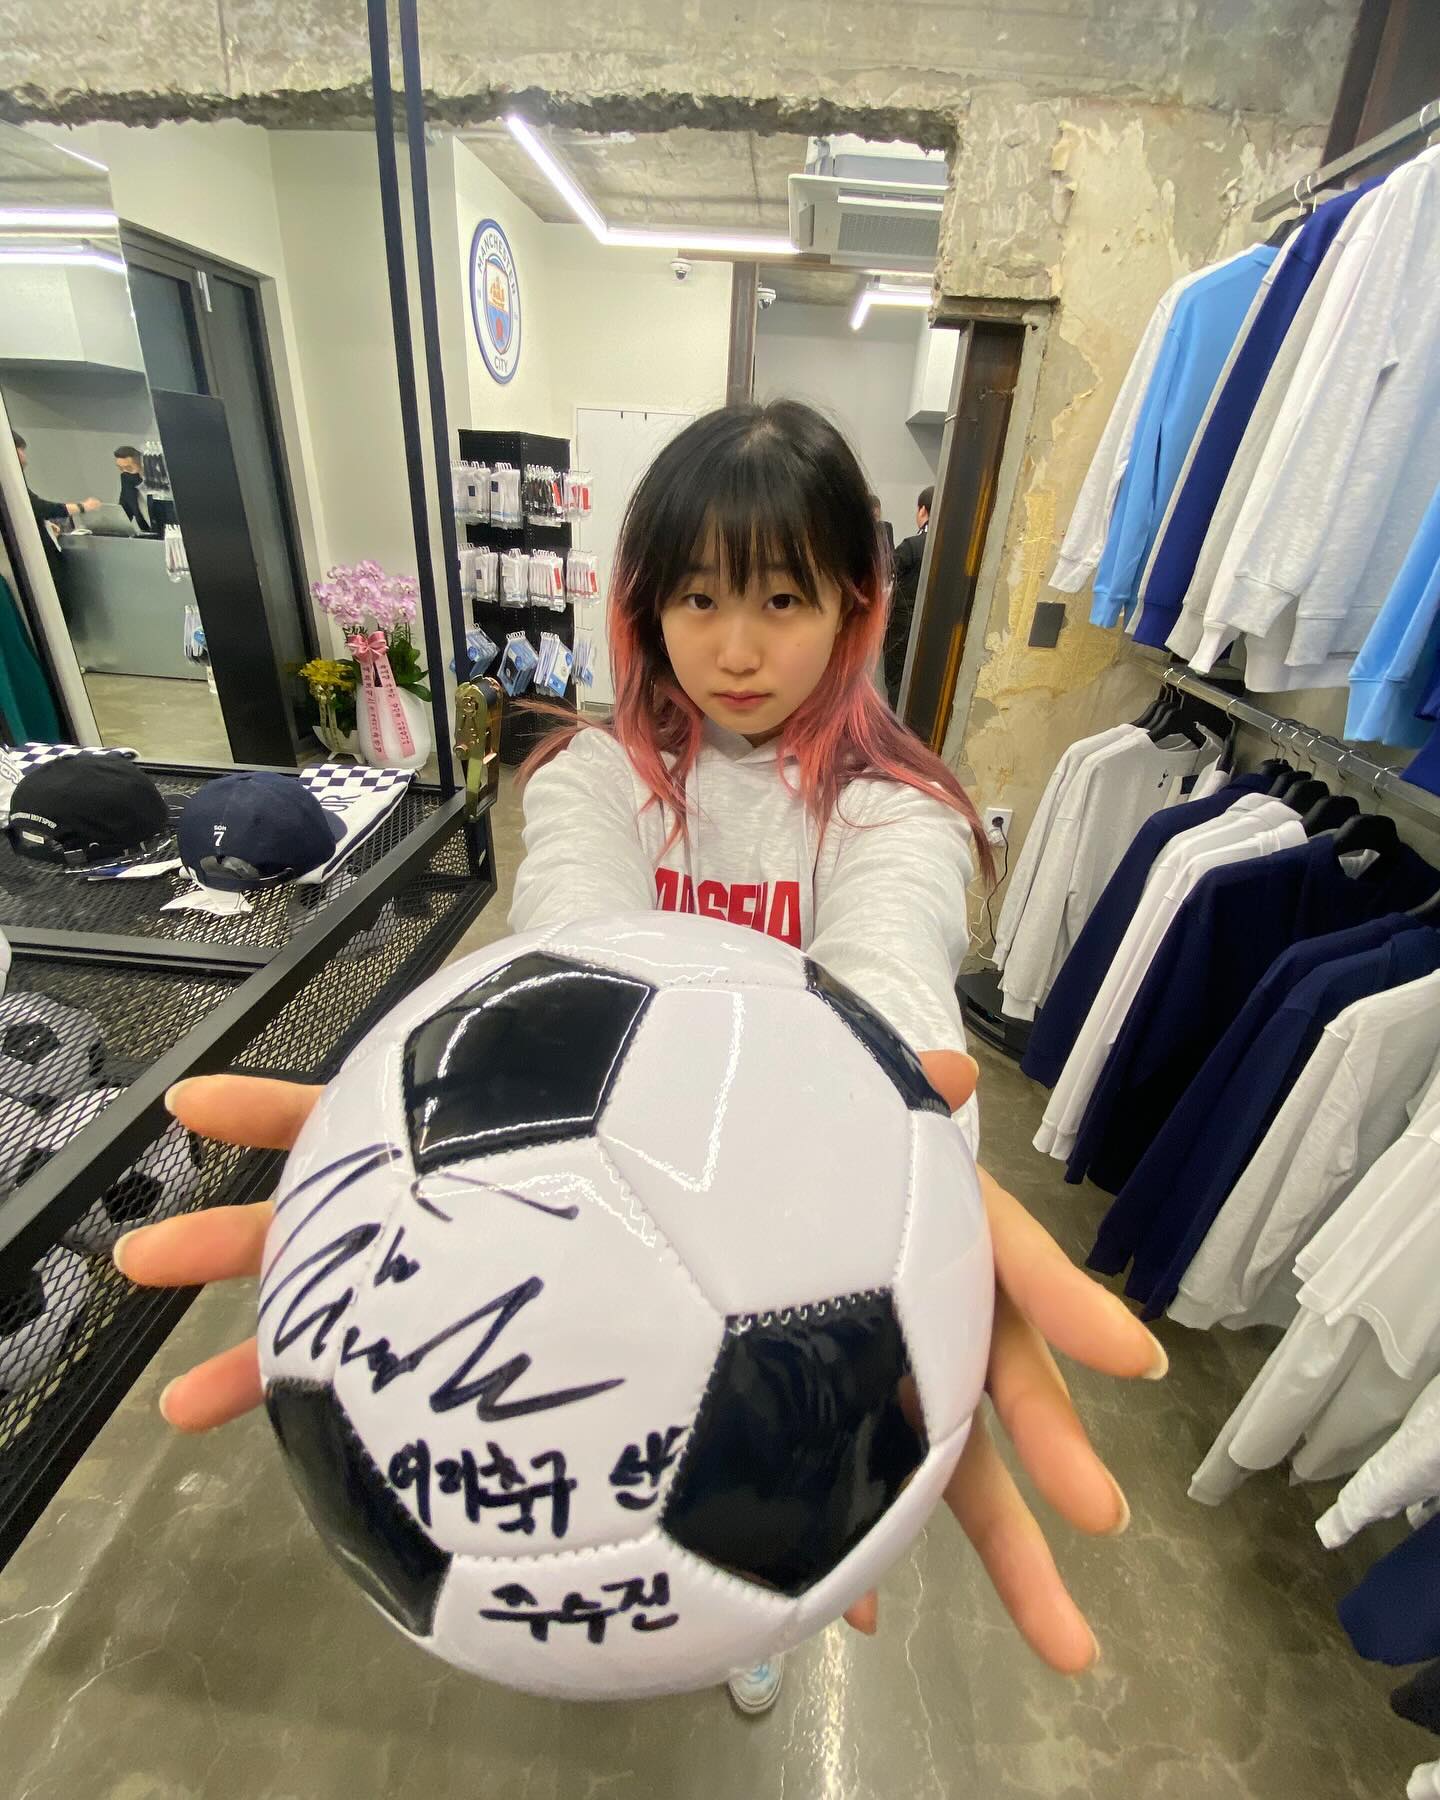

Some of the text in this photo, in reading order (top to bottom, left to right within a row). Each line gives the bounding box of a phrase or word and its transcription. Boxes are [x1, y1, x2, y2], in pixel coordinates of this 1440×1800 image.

[477, 233, 516, 295] MANCHESTER
[494, 356, 509, 373] CITY
[213, 831, 225, 847] 7
